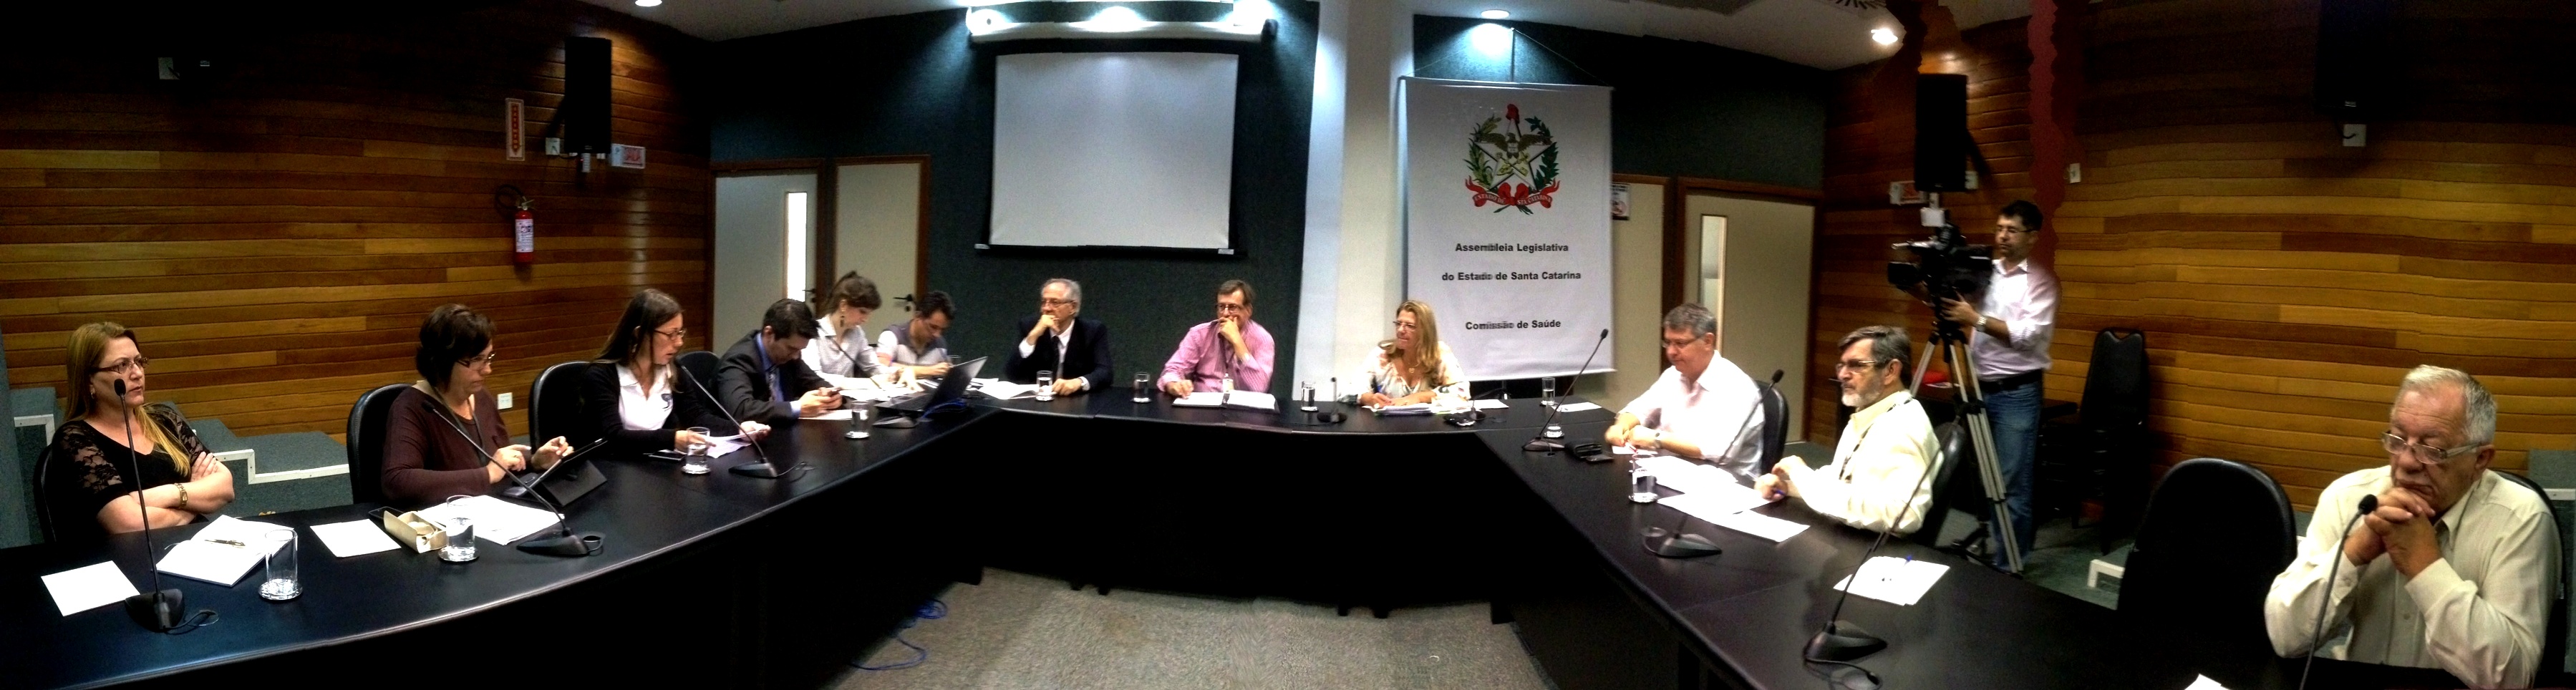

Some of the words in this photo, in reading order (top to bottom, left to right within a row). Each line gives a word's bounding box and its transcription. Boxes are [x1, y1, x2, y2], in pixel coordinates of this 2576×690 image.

[1455, 243, 1514, 252] Assembleia
[1516, 243, 1569, 254] Legislativa
[1441, 272, 1455, 281] do
[1458, 272, 1493, 281] Estado
[1496, 271, 1508, 281] de
[1511, 271, 1539, 280] Santa
[1541, 271, 1582, 280] Catarina
[1516, 320, 1529, 329] de
[1531, 319, 1561, 329] Saúde
